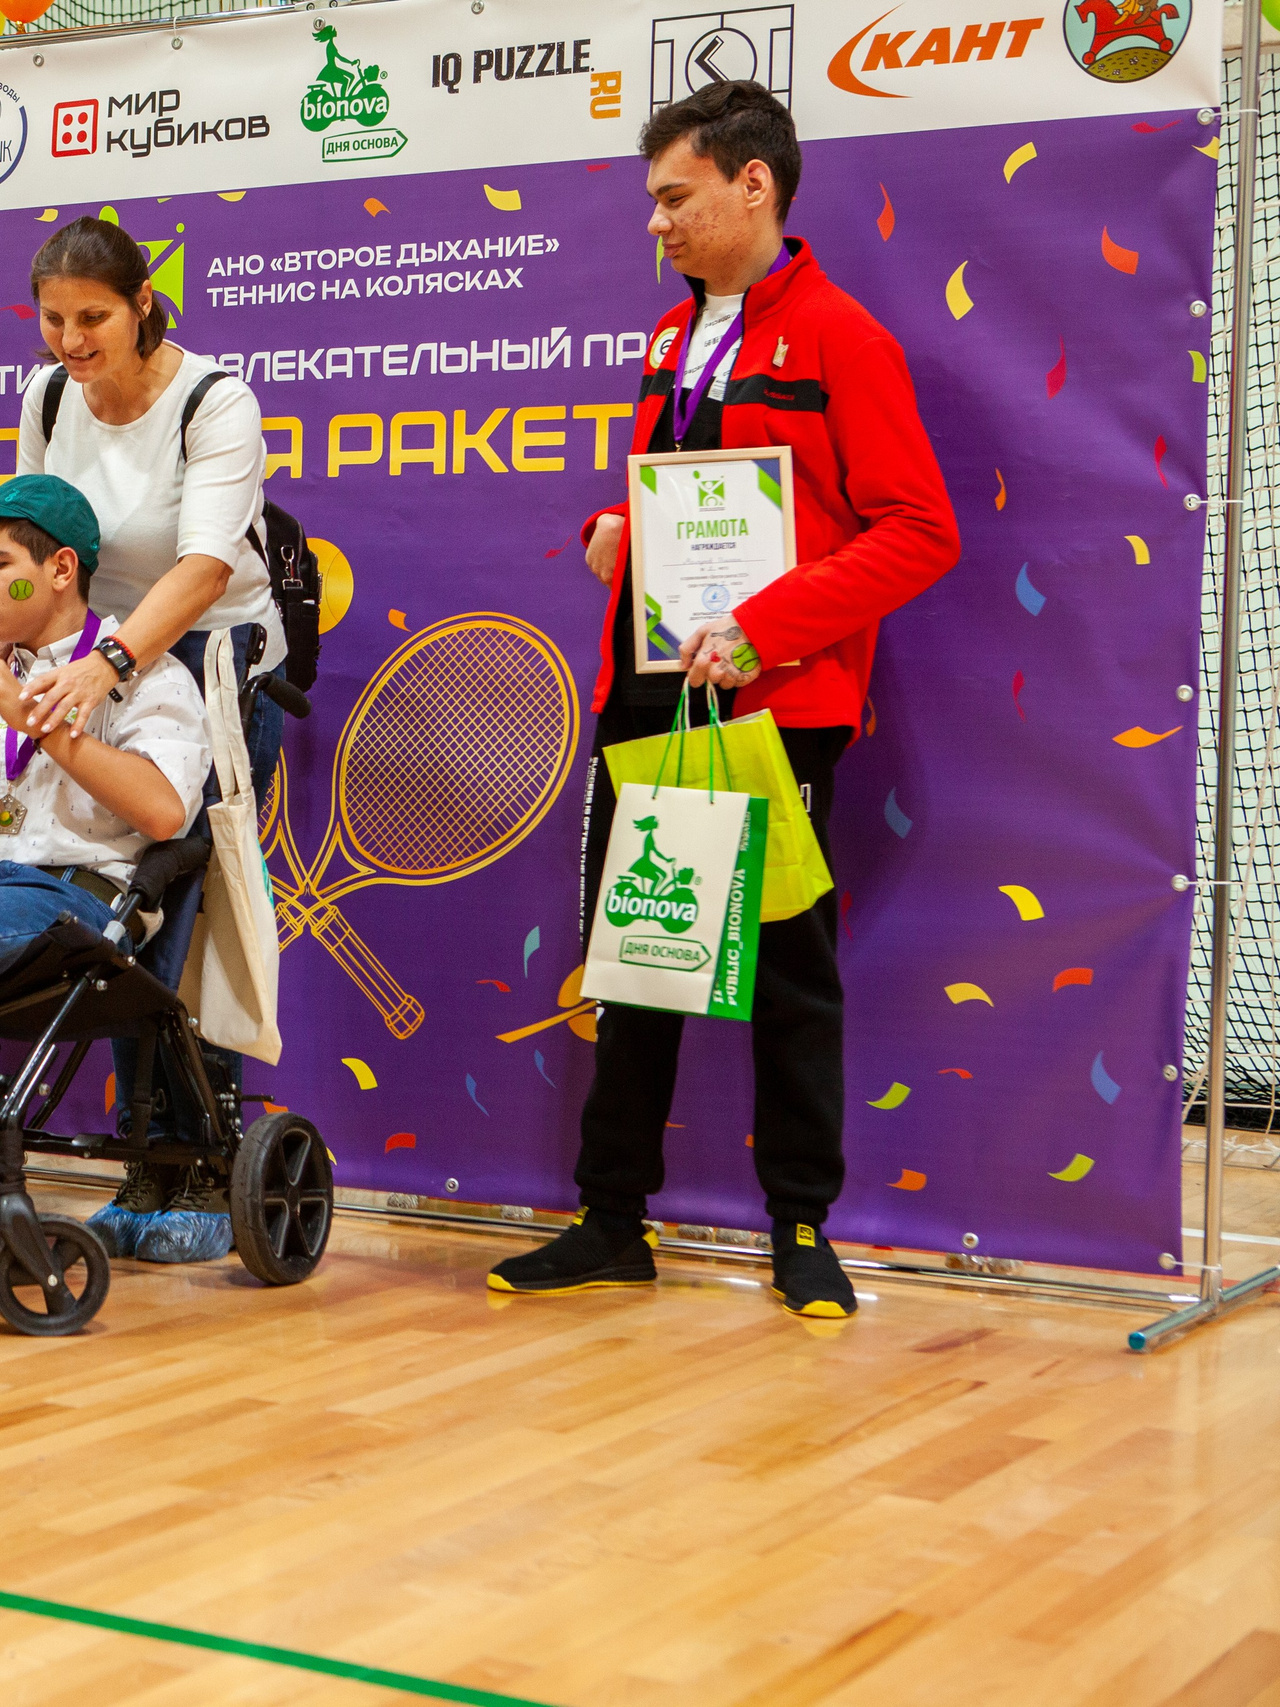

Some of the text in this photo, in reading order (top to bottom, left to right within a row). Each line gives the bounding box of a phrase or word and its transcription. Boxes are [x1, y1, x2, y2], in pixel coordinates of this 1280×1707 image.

[861, 17, 1045, 72] КАНТ
[431, 52, 462, 94] IQ
[302, 95, 388, 121] bionova
[589, 70, 622, 120] RU
[325, 135, 400, 156] ДНЯ ОСНОВА
[206, 233, 560, 278] АНО «ВТОРОЕ ДЫХАНИЕ»
[206, 267, 524, 308] ТЕННИС НА КОЛЯСКАХ
[200, 326, 573, 383] ВЛЕКАТЕЛЬНЫЙ
[583, 330, 654, 368] ПР
[327, 403, 634, 478] РАКЕТ
[677, 518, 749, 540] ГРАМОТА
[607, 887, 698, 922] bionova
[624, 941, 701, 962] ДНЯ ОСНОВА
[726, 868, 746, 1007] PUBLIC_BIONOVA
